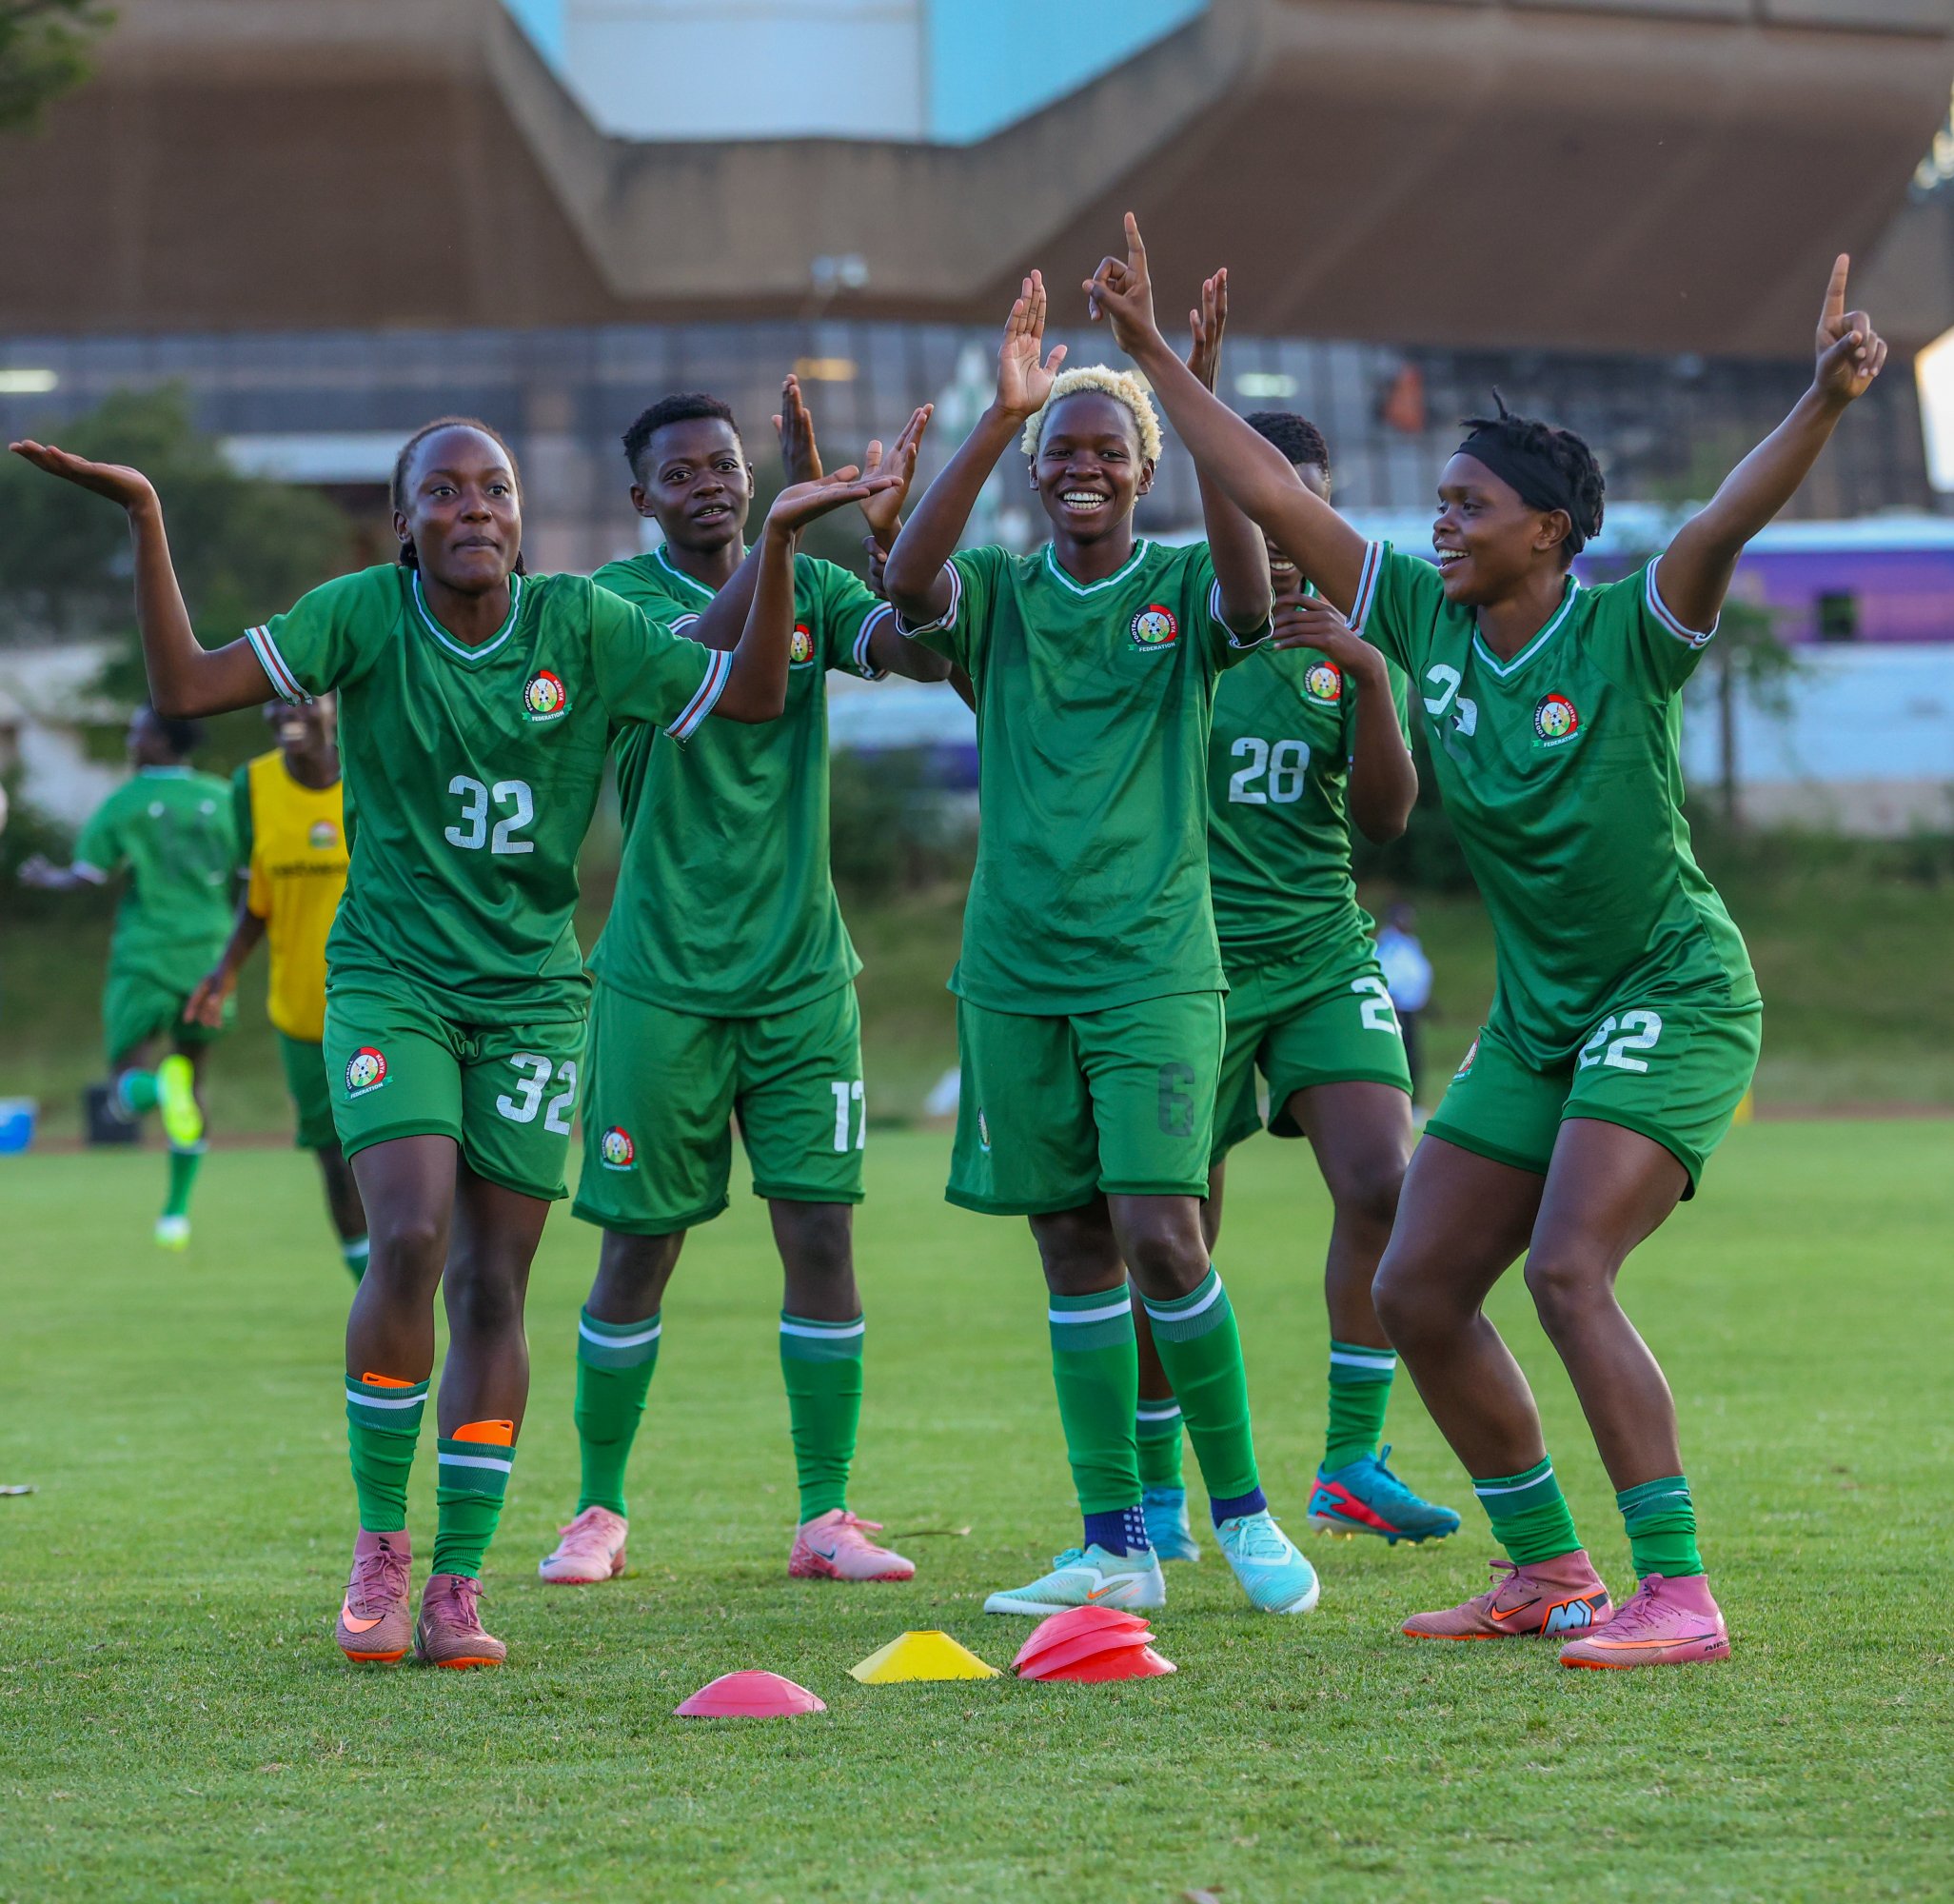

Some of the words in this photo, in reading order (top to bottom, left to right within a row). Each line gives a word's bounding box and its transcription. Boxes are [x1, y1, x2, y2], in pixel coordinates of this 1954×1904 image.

[1131, 613, 1141, 644] FOOTBALL
[1138, 642, 1176, 652] FEDERATION
[524, 680, 534, 711] FOOTBALL
[553, 679, 564, 702] KENYA
[531, 710, 565, 722] FEDERATION
[1534, 705, 1546, 738] FOOTBALL
[1564, 702, 1576, 723] KENYA
[1543, 731, 1579, 747] FEDERATION
[1228, 737, 1311, 805] 28
[444, 775, 535, 854] 32
[1351, 976, 1403, 1036] 2
[1578, 1010, 1663, 1074] 22
[375, 1054, 385, 1074] KENYA
[350, 1081, 384, 1100] FEDERATION
[496, 1052, 577, 1136] 32
[1157, 1061, 1194, 1138] 6
